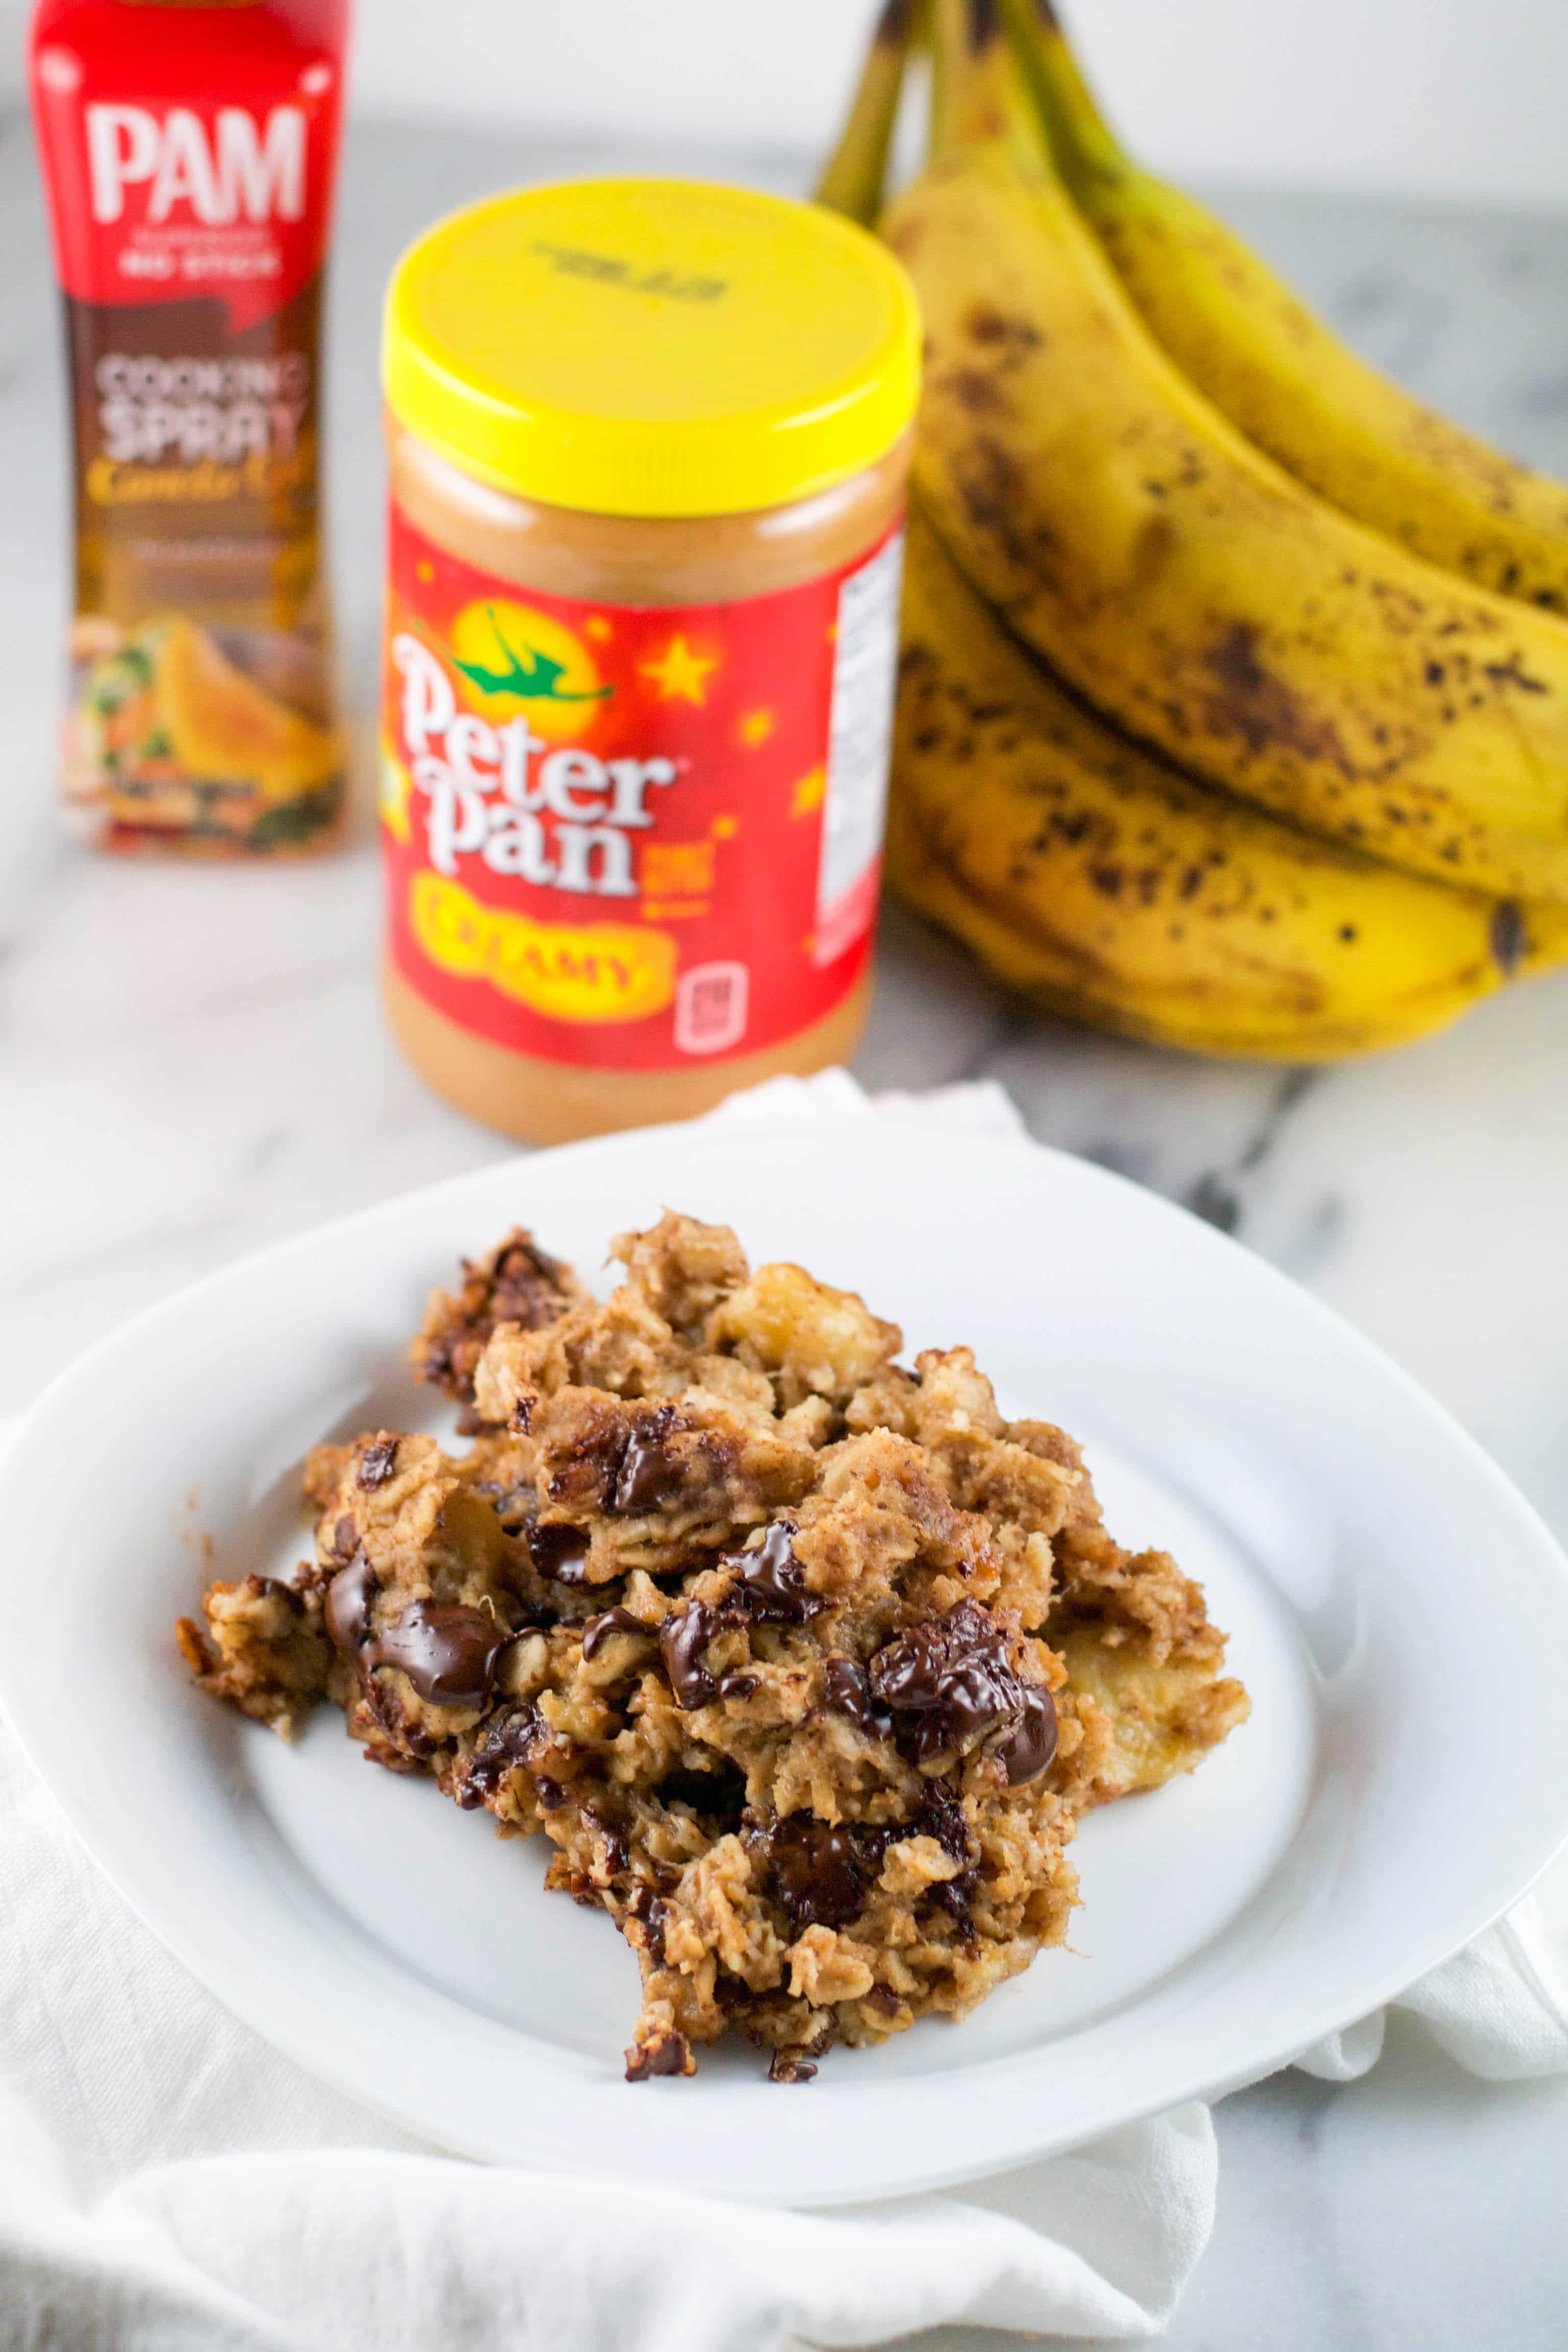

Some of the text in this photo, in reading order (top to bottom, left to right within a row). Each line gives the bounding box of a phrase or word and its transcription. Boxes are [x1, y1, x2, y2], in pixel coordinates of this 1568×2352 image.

[86, 104, 305, 224] PAM
[393, 633, 676, 828] Peter
[412, 754, 639, 897] Pan
